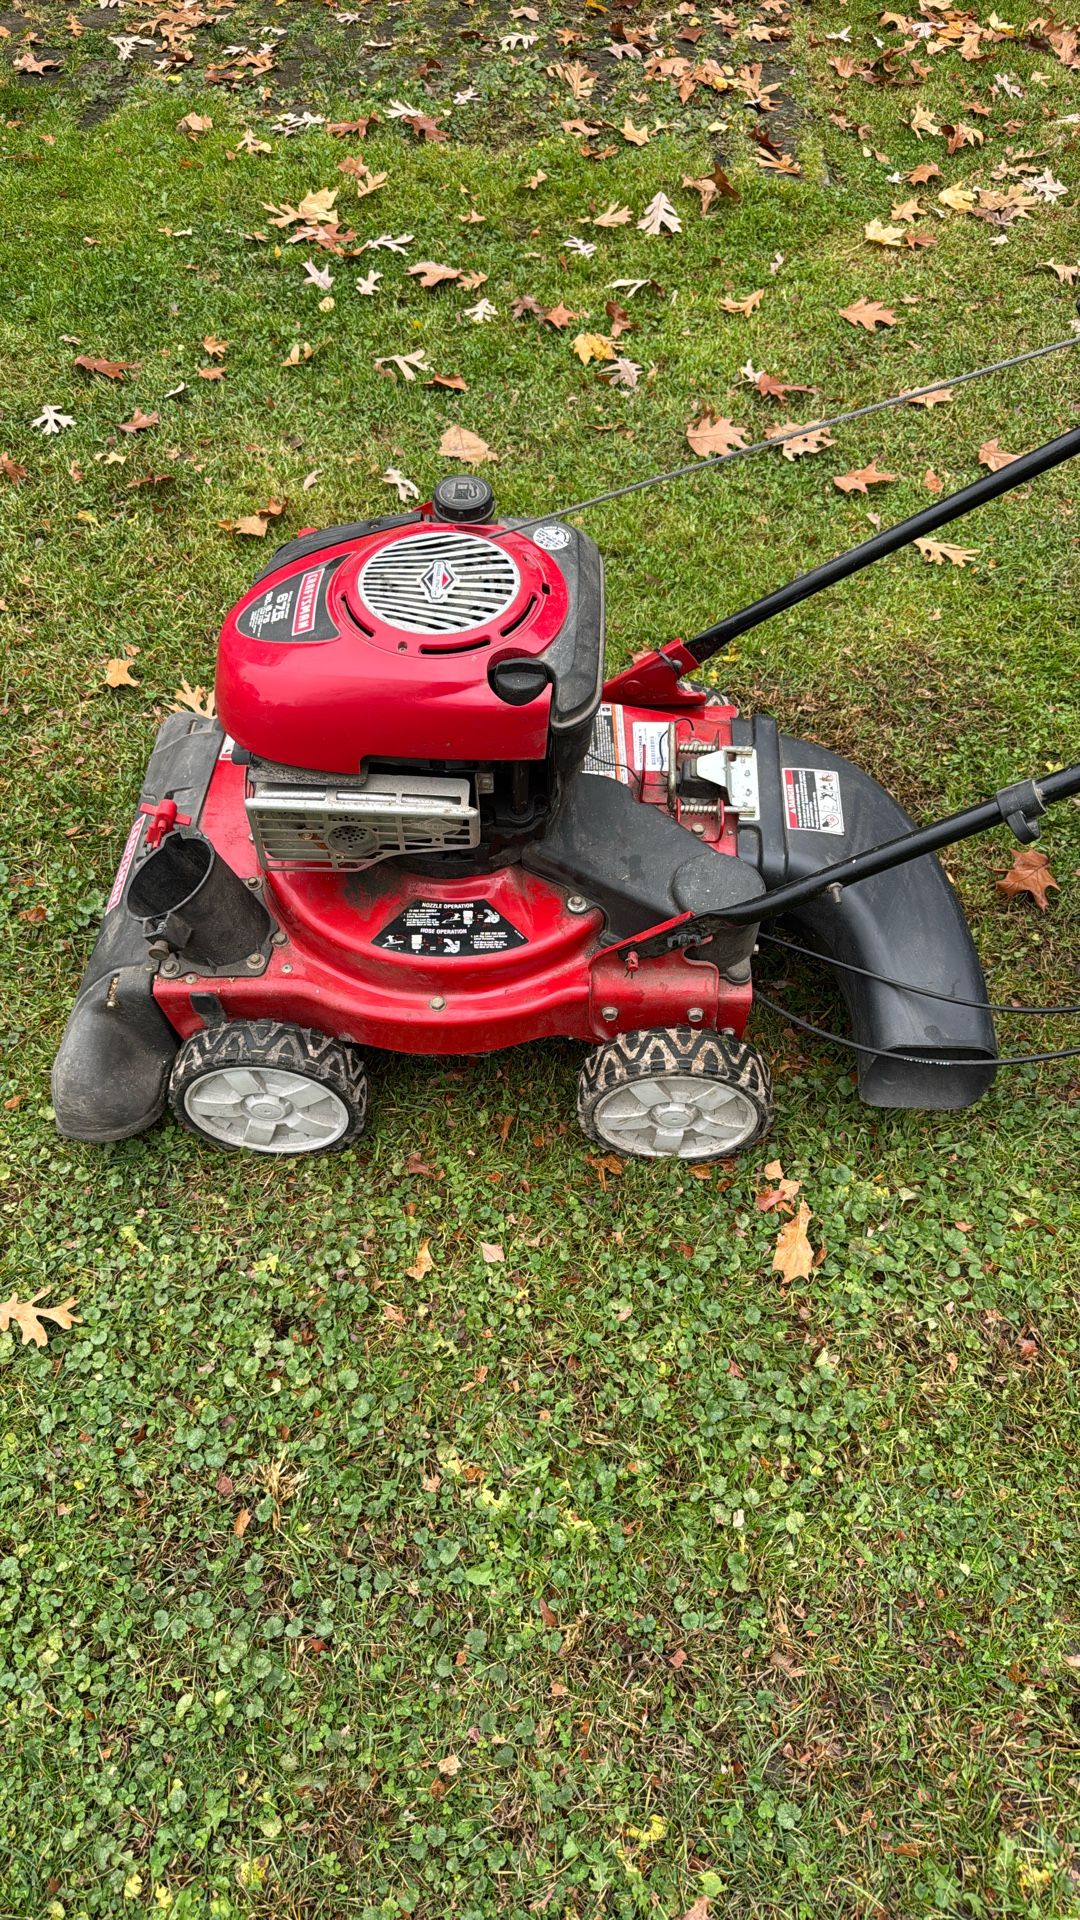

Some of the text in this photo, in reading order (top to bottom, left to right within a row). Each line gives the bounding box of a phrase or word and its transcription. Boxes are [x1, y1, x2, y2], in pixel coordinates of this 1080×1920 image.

[275, 592, 289, 620] 675
[298, 573, 319, 630] CRAFTSMAN
[786, 784, 796, 809] DANGER
